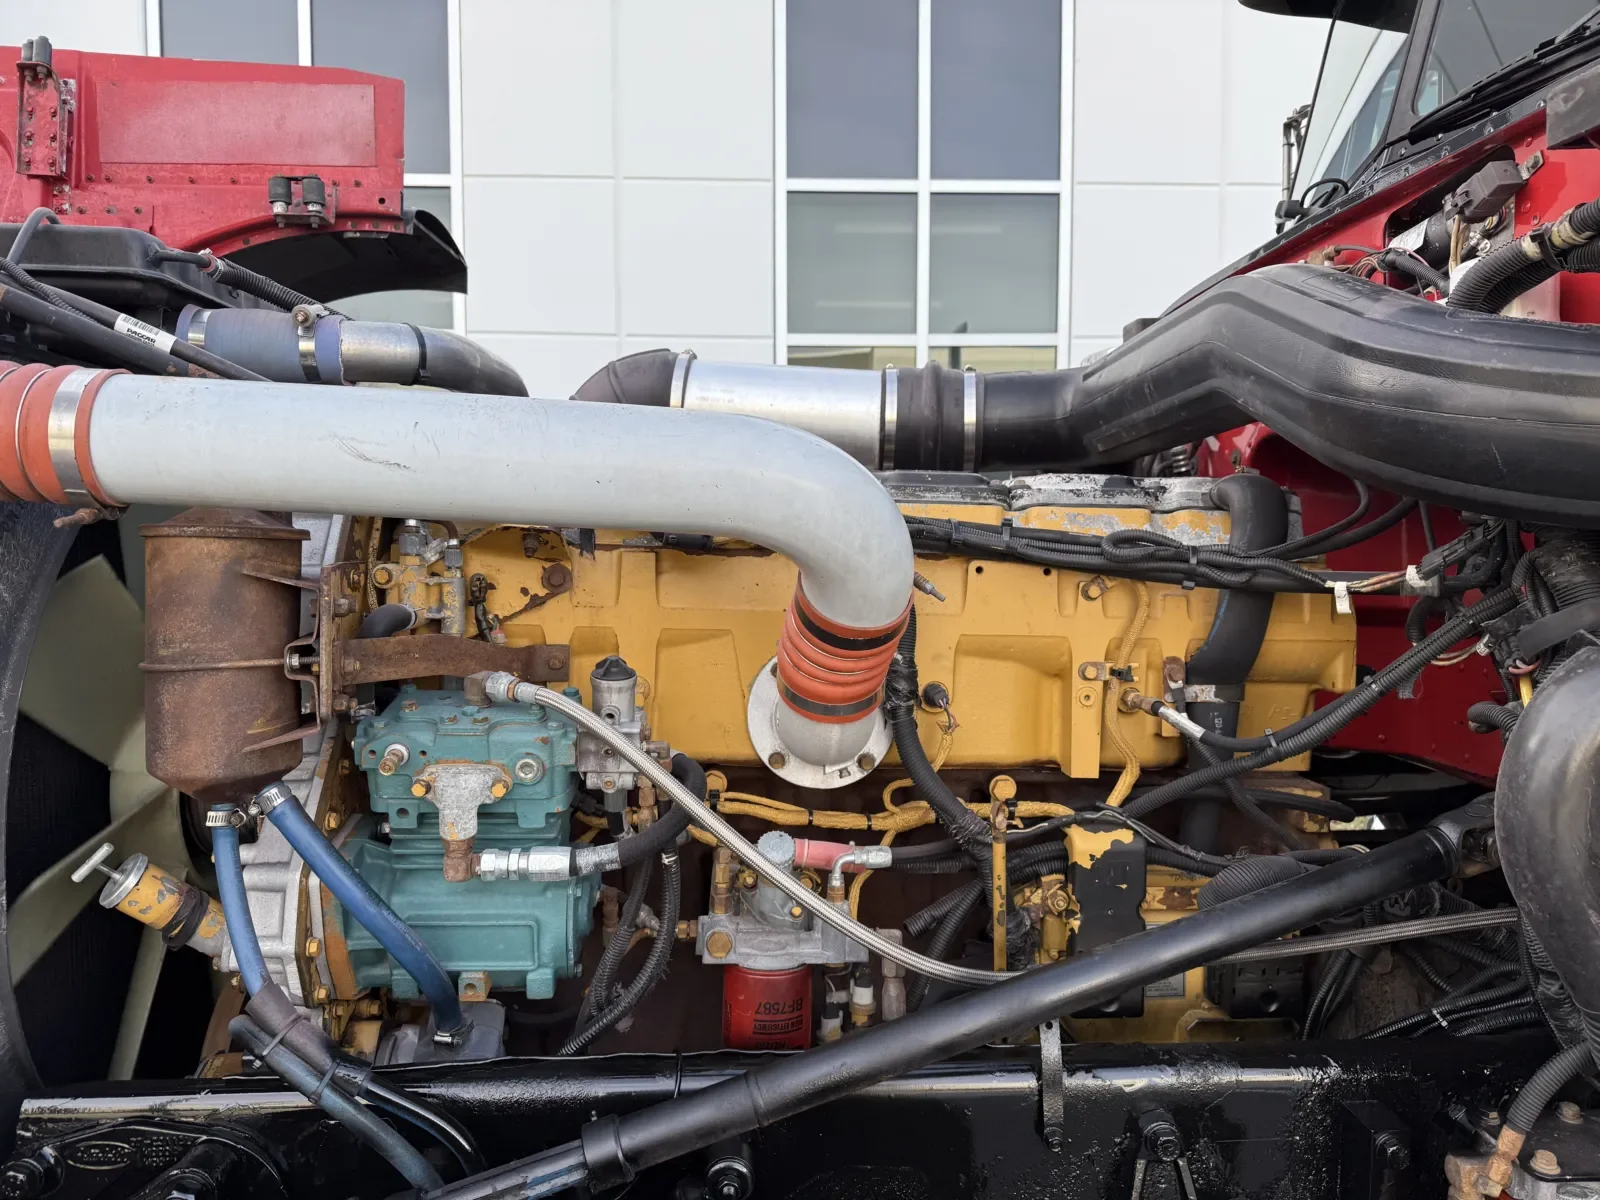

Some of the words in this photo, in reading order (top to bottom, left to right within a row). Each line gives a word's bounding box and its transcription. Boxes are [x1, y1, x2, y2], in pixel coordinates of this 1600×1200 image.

[126, 328, 156, 344] PACCAR
[755, 997, 803, 1015] BF7587
[753, 1022, 790, 1032] EFFICIENCY
